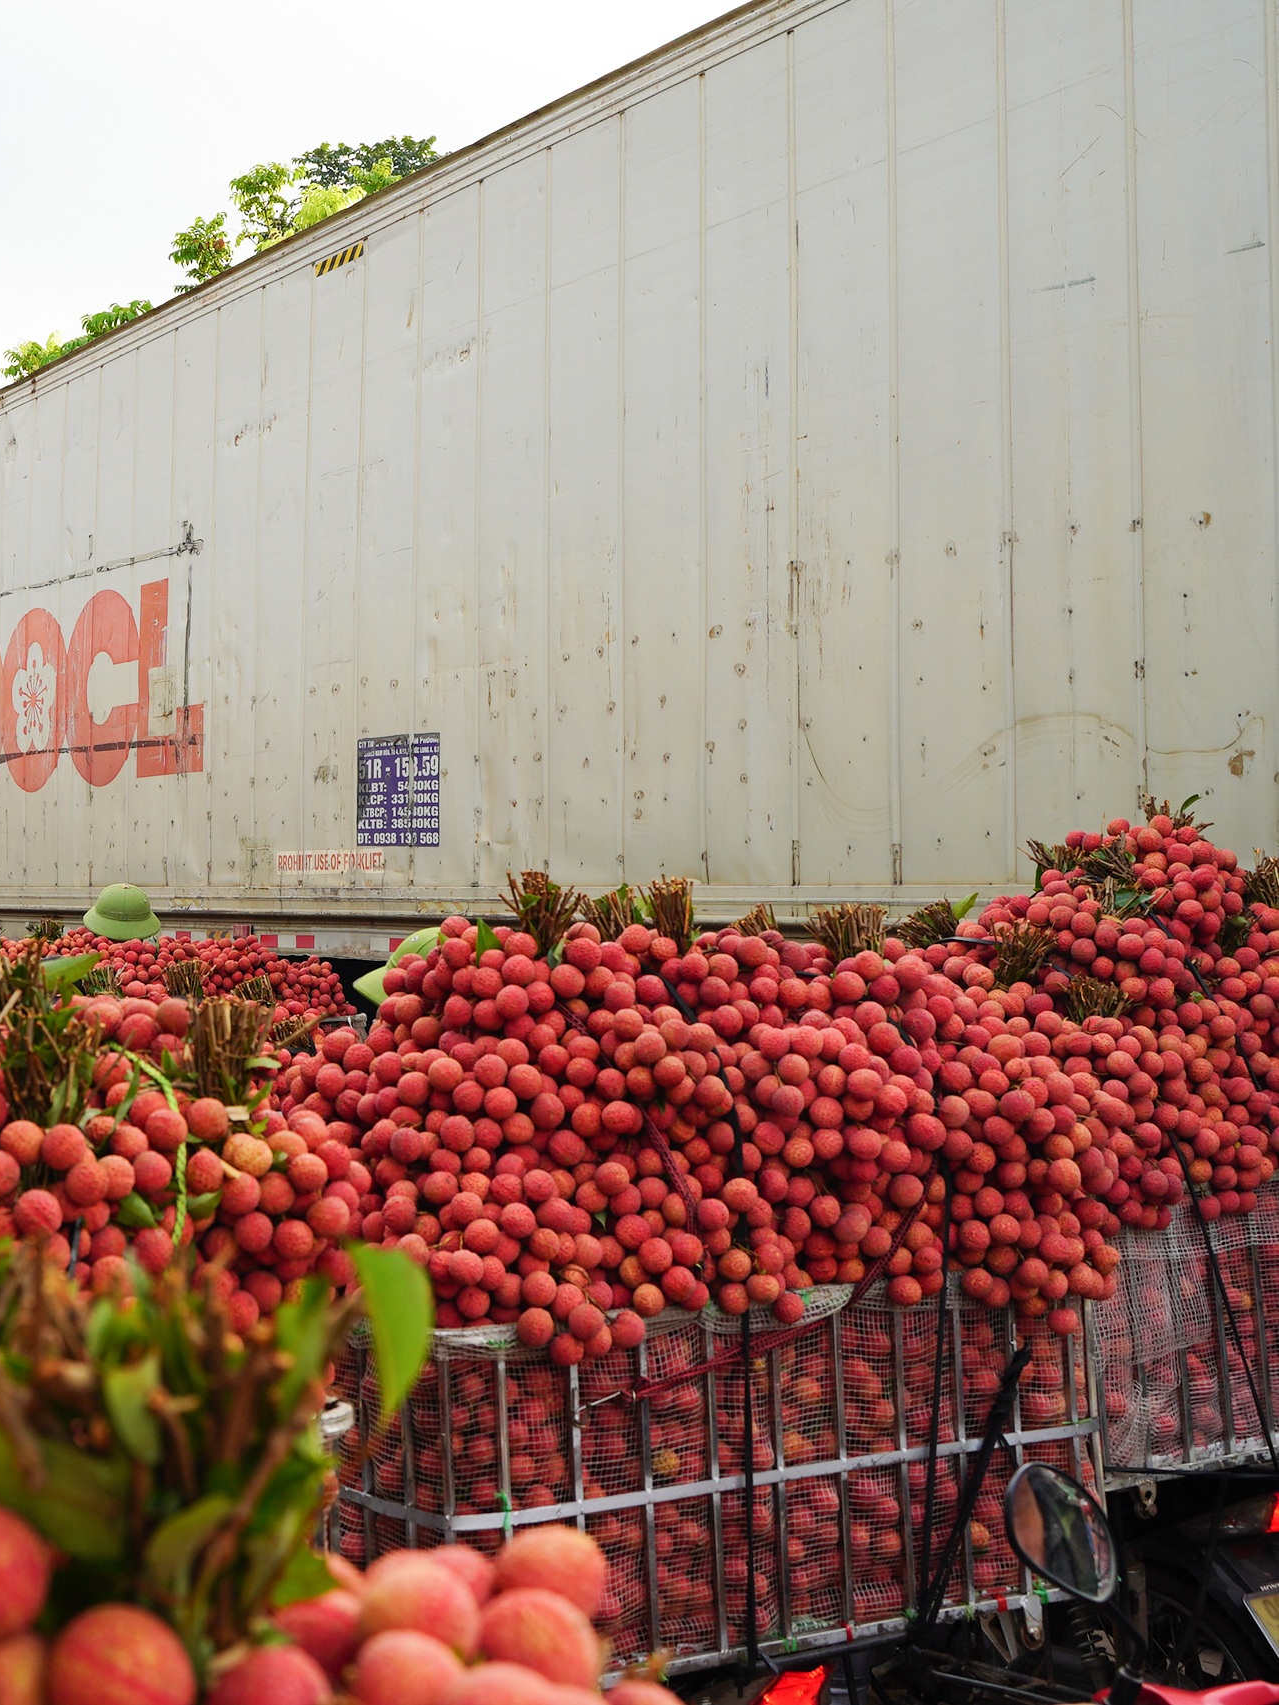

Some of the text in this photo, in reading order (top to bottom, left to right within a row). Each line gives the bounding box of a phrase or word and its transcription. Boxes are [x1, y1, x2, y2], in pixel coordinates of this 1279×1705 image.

[359, 758, 382, 779] 51R
[357, 819, 387, 829] KLTB:
[373, 832, 397, 844] 0938
[420, 832, 439, 844] 568
[314, 853, 329, 871] USE
[330, 853, 341, 871] OF
